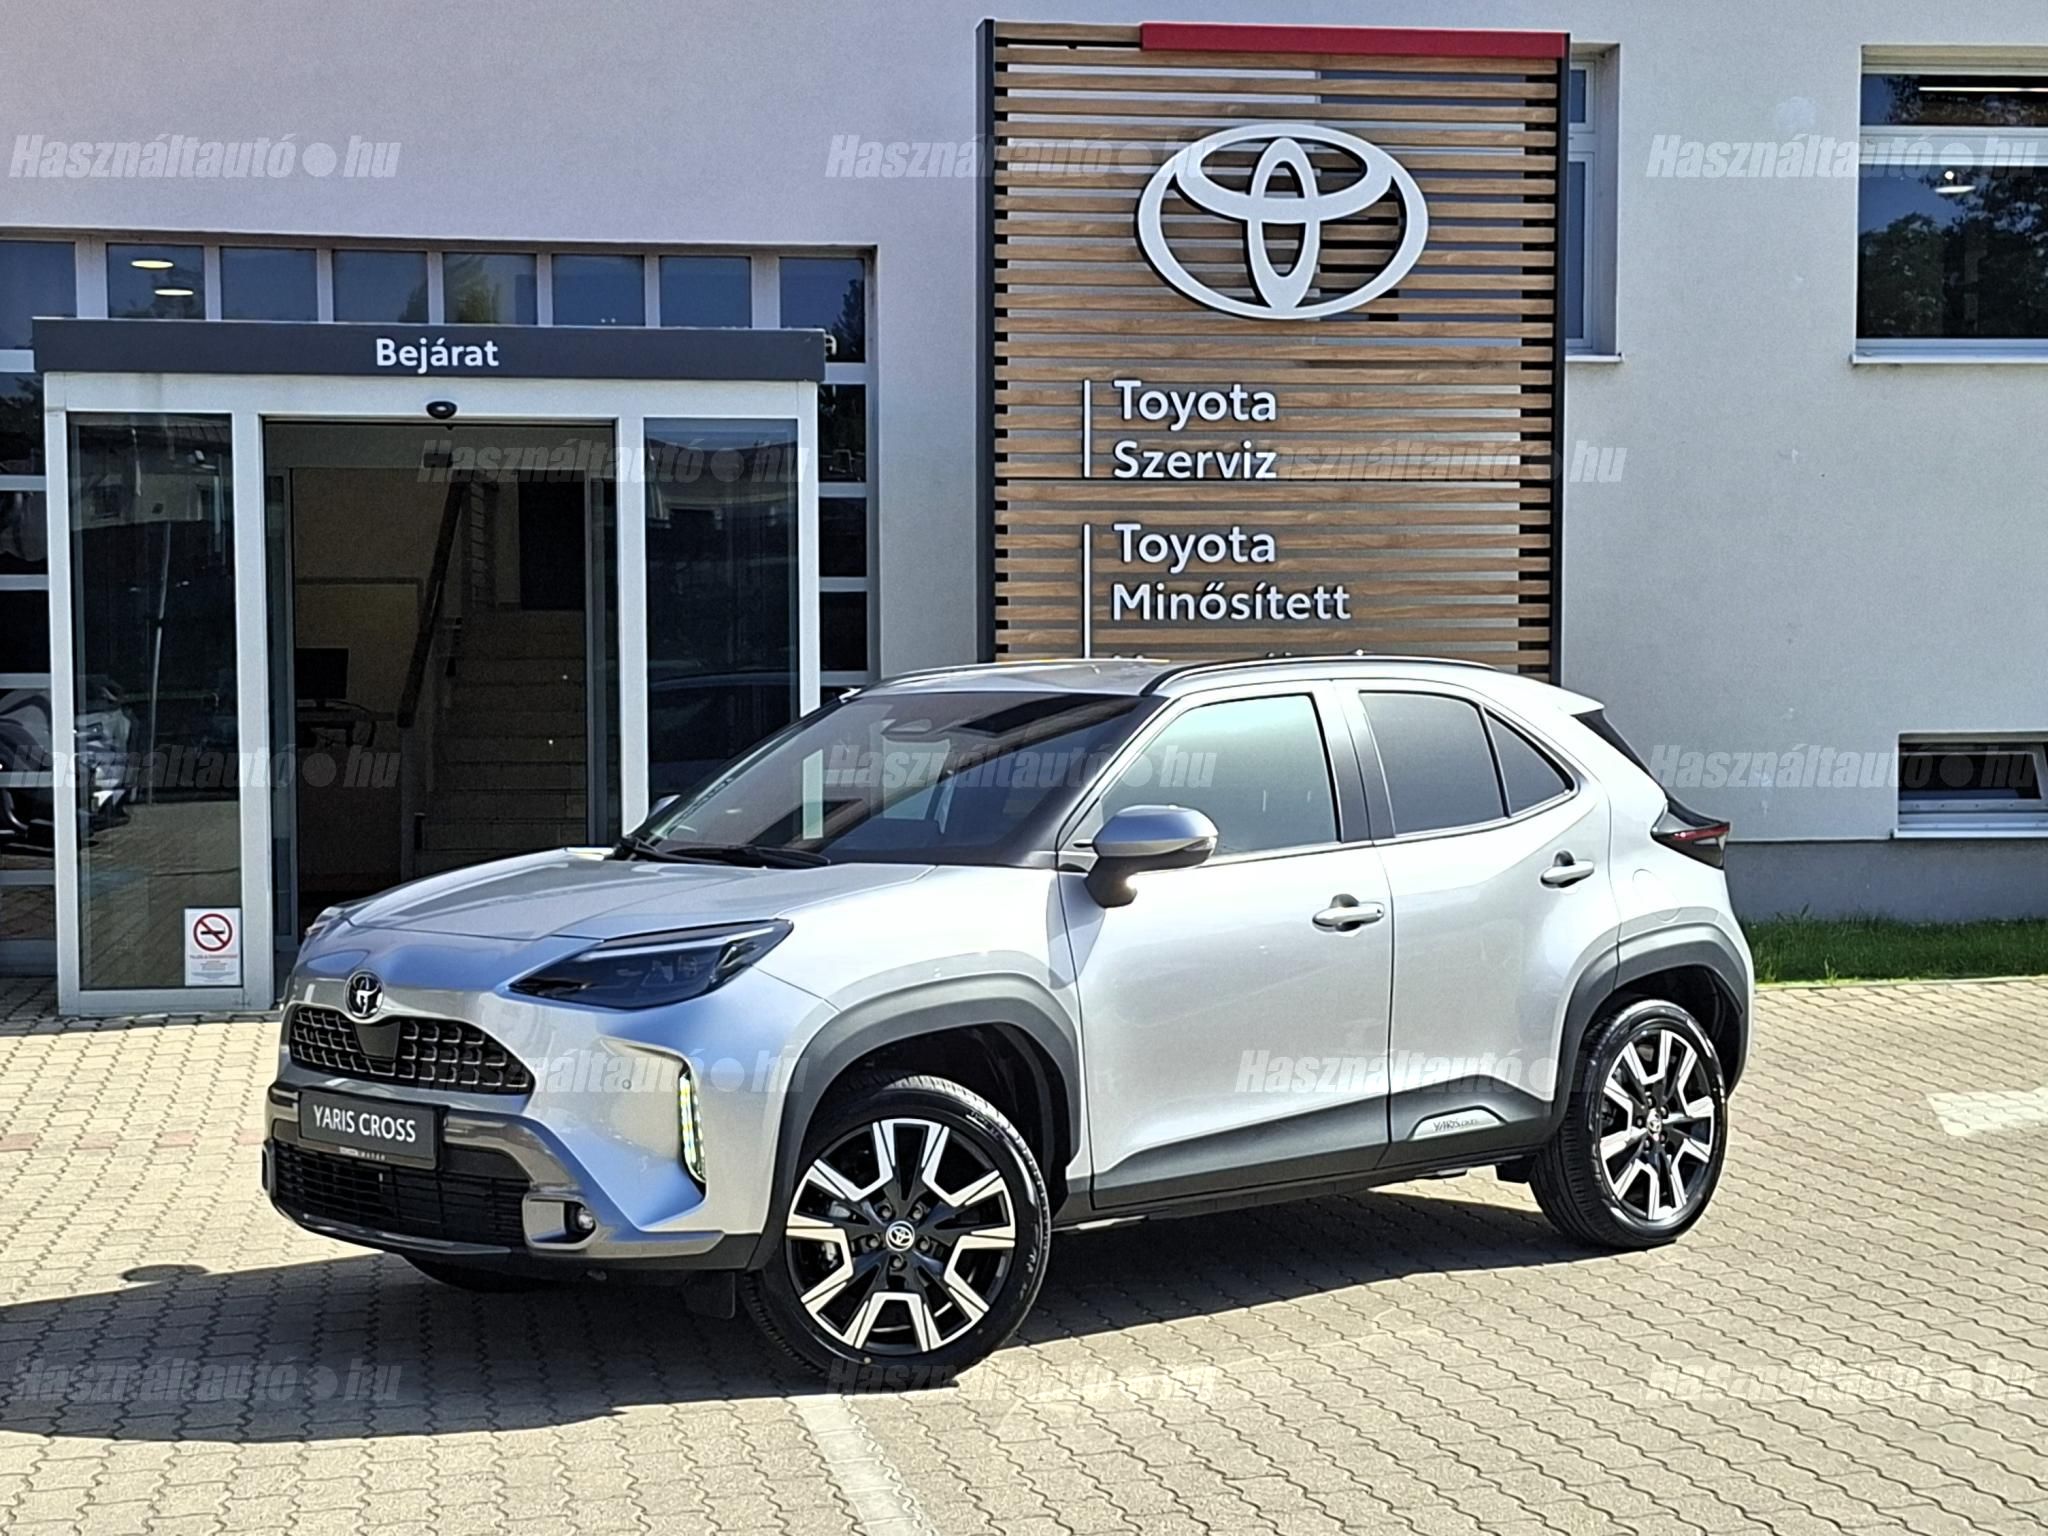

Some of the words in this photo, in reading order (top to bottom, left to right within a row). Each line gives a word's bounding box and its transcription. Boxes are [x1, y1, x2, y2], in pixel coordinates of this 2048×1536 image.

[376, 337, 499, 374] Bejárat
[1114, 380, 1276, 431] Toyota
[1114, 440, 1277, 479] Szerviz
[1113, 523, 1276, 574] Toyota
[1113, 582, 1350, 620] Minősített
[313, 1104, 355, 1133] YARIS
[359, 1113, 416, 1143] CROSS
